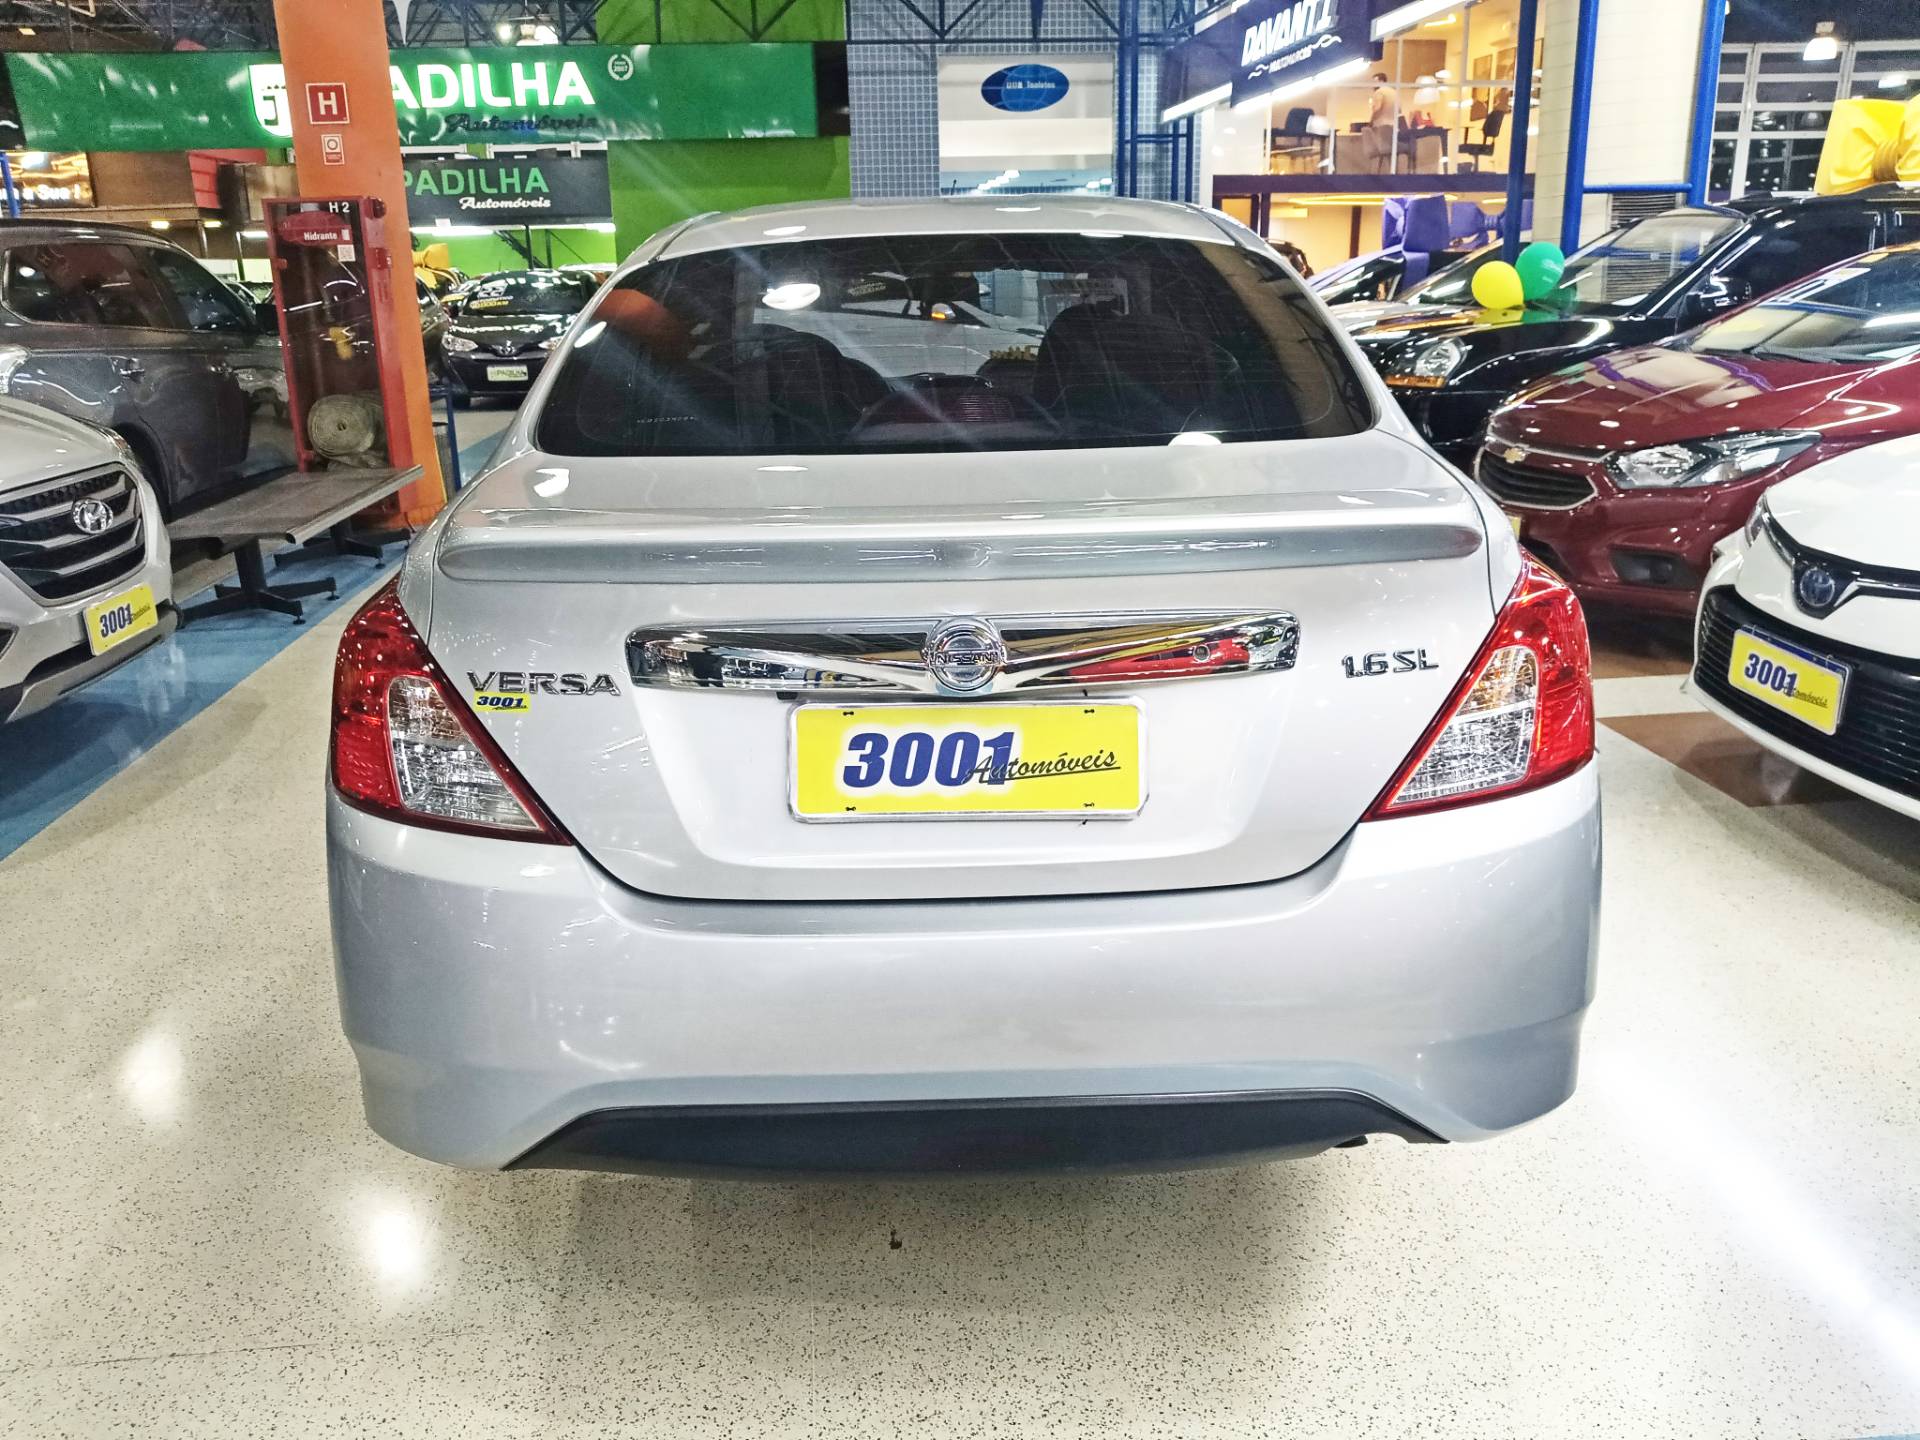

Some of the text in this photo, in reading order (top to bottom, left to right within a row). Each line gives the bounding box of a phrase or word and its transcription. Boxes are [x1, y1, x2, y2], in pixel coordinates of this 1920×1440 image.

[389, 62, 596, 109] ADILHA
[317, 91, 338, 115] H
[328, 201, 351, 213] H 2
[459, 197, 551, 210] Automóveis
[303, 231, 338, 241] Hidrante
[99, 603, 132, 638] 3001
[935, 650, 993, 665] NISSAN
[466, 671, 622, 696] VERSA
[1744, 652, 1797, 697] 3001
[476, 695, 524, 708] 3001
[843, 731, 1015, 788] 3001
[960, 749, 1121, 784] Automóveis
